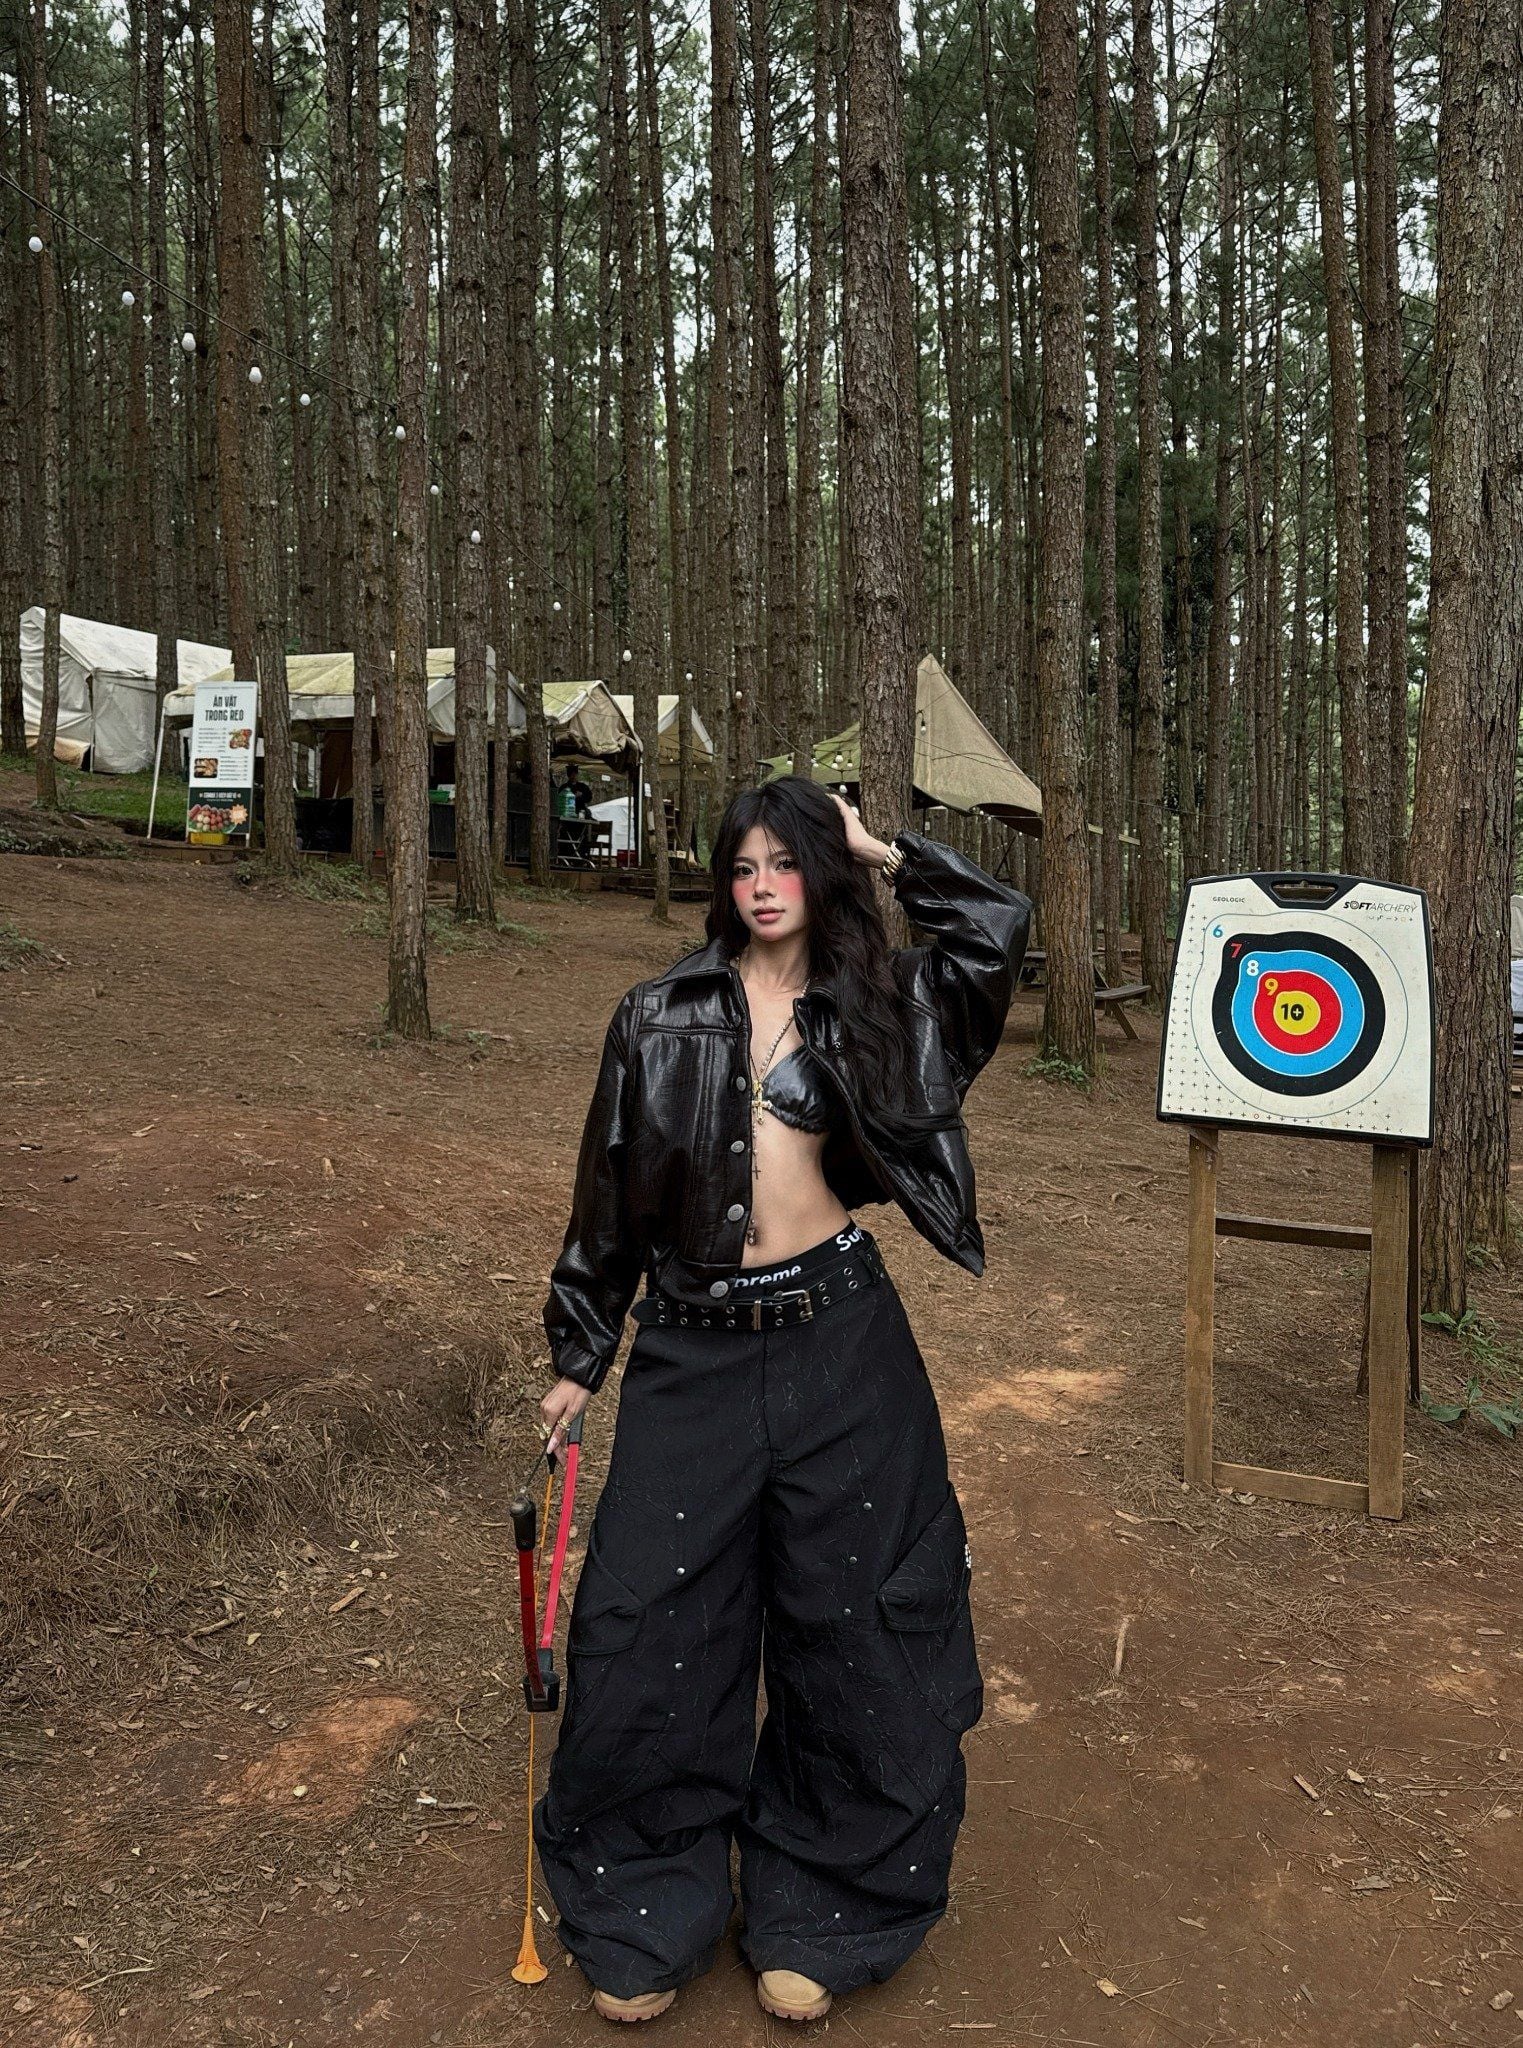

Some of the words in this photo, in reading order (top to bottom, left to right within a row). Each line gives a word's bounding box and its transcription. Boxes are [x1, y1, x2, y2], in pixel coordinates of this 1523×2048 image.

[1212, 924, 1223, 938] 6
[1230, 942, 1243, 958] 7
[1246, 959, 1259, 976] 8
[1264, 978, 1278, 996] 9
[1281, 1003, 1304, 1021] 10
